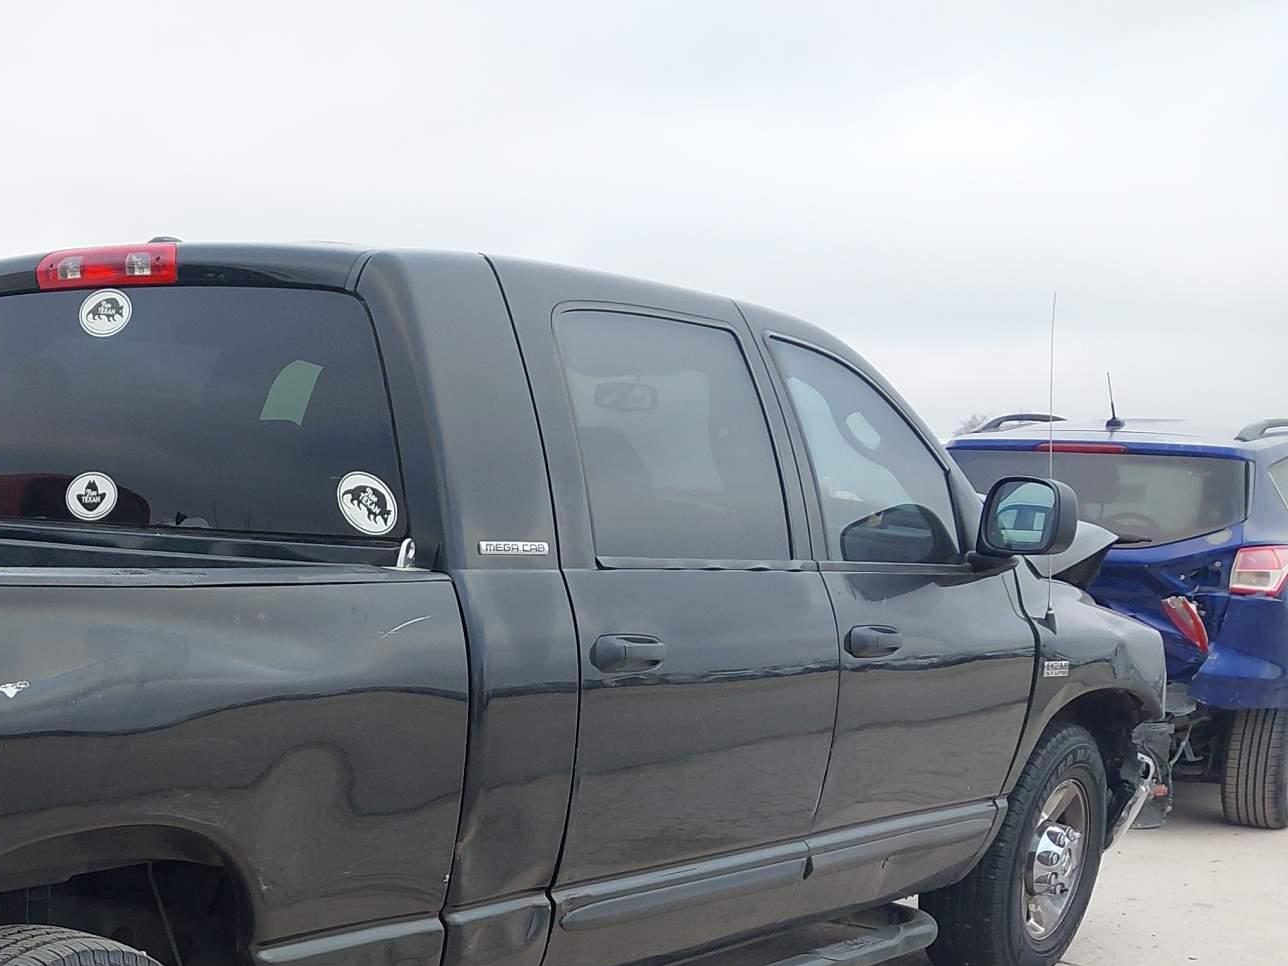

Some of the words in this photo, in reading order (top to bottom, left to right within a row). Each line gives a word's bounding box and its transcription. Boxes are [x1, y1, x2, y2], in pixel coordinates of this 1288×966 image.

[81, 495, 101, 504] TEXAN
[485, 543, 519, 552] MEGA
[522, 543, 546, 553] CAB
